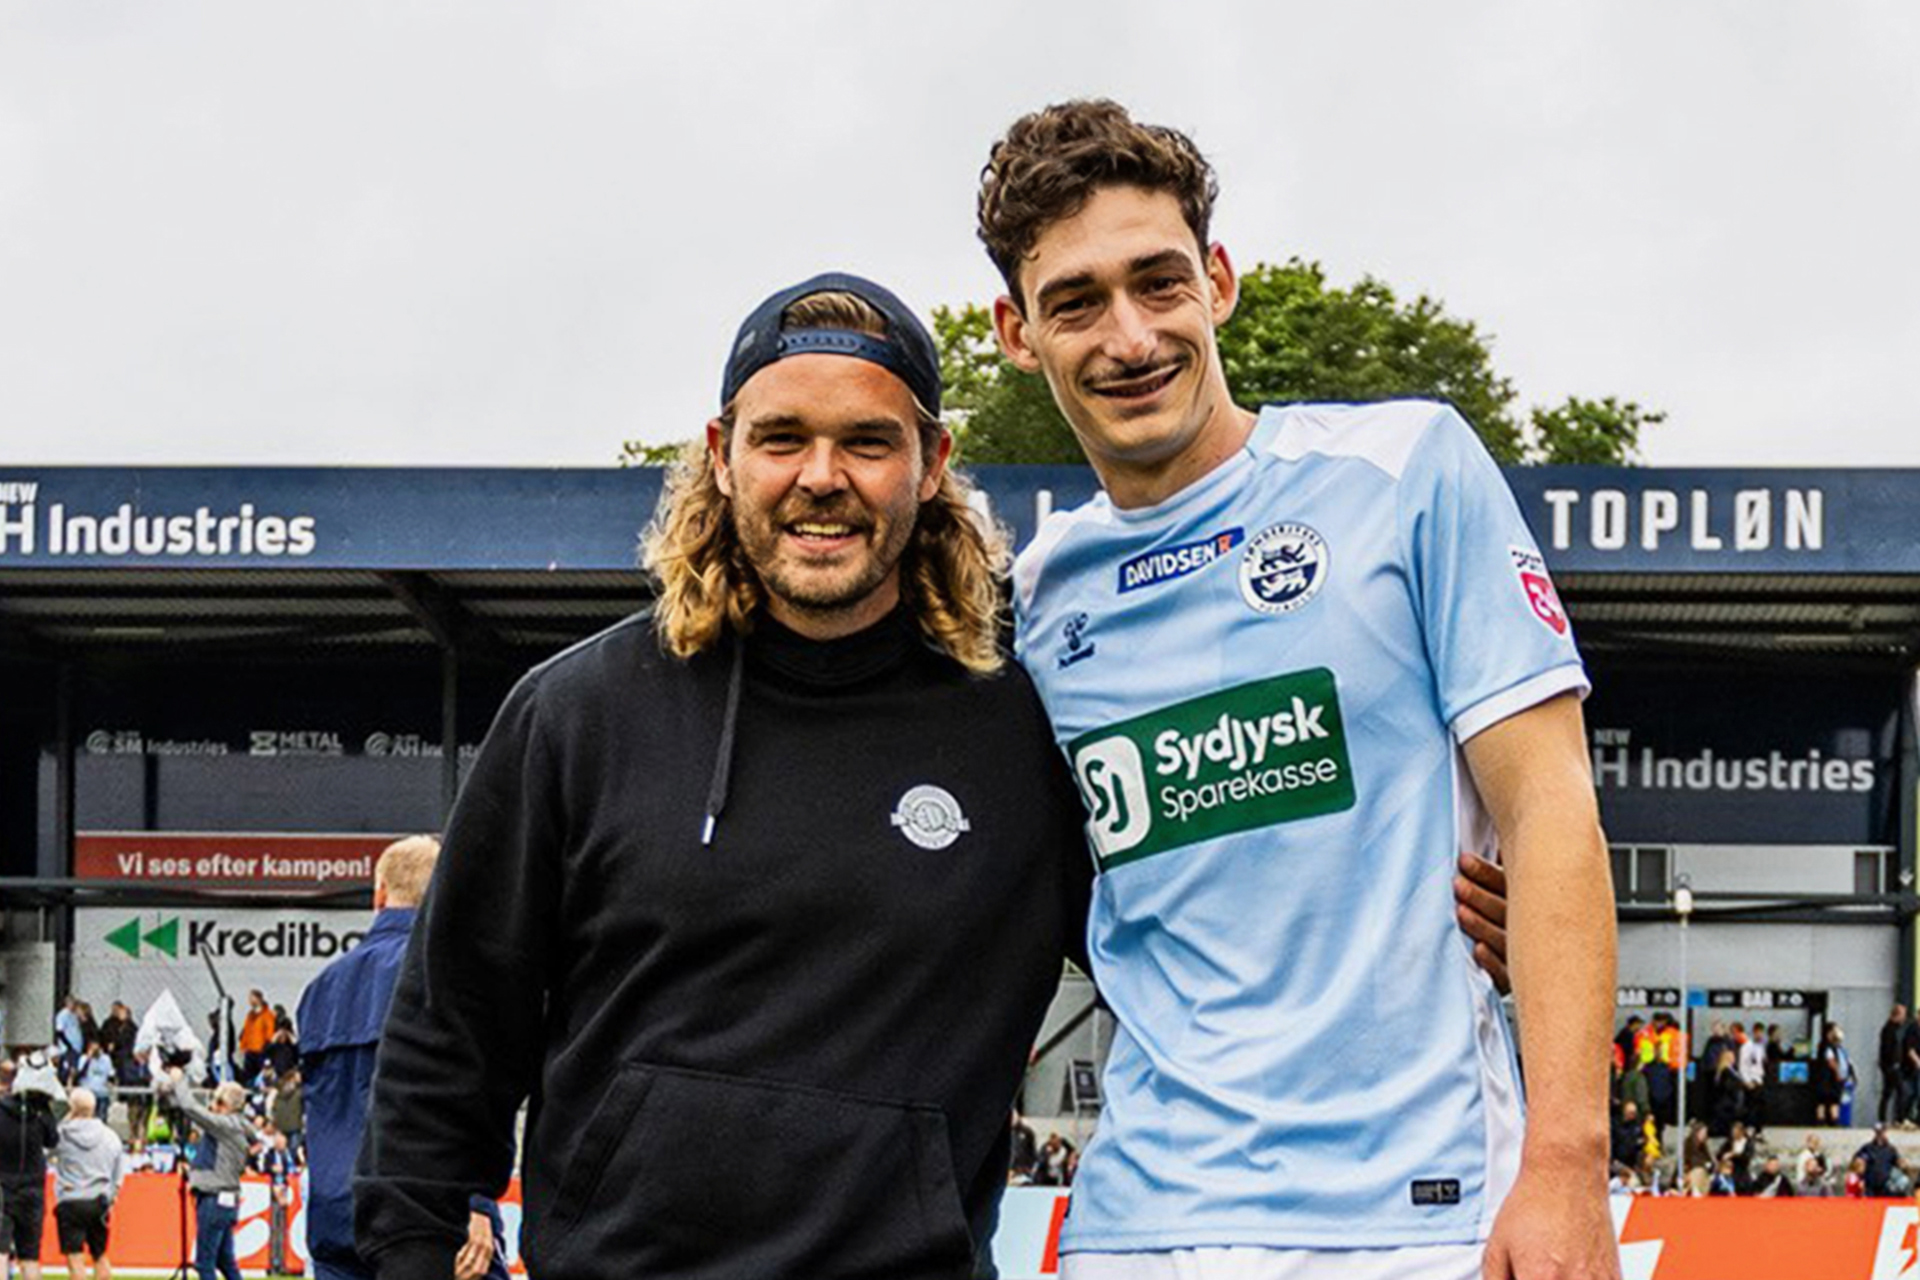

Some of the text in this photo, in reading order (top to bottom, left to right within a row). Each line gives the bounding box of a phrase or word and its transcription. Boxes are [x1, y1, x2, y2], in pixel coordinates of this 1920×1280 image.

[49, 503, 316, 556] Industries
[1544, 488, 1824, 552] TOPLØN
[280, 732, 343, 749] METAL
[1154, 696, 1329, 781] Sydjysk
[1594, 730, 1631, 745] NEW
[1160, 757, 1337, 822] Sparekasse
[1641, 748, 1875, 791] Industries
[118, 853, 372, 881] Vi ses efter kampen!
